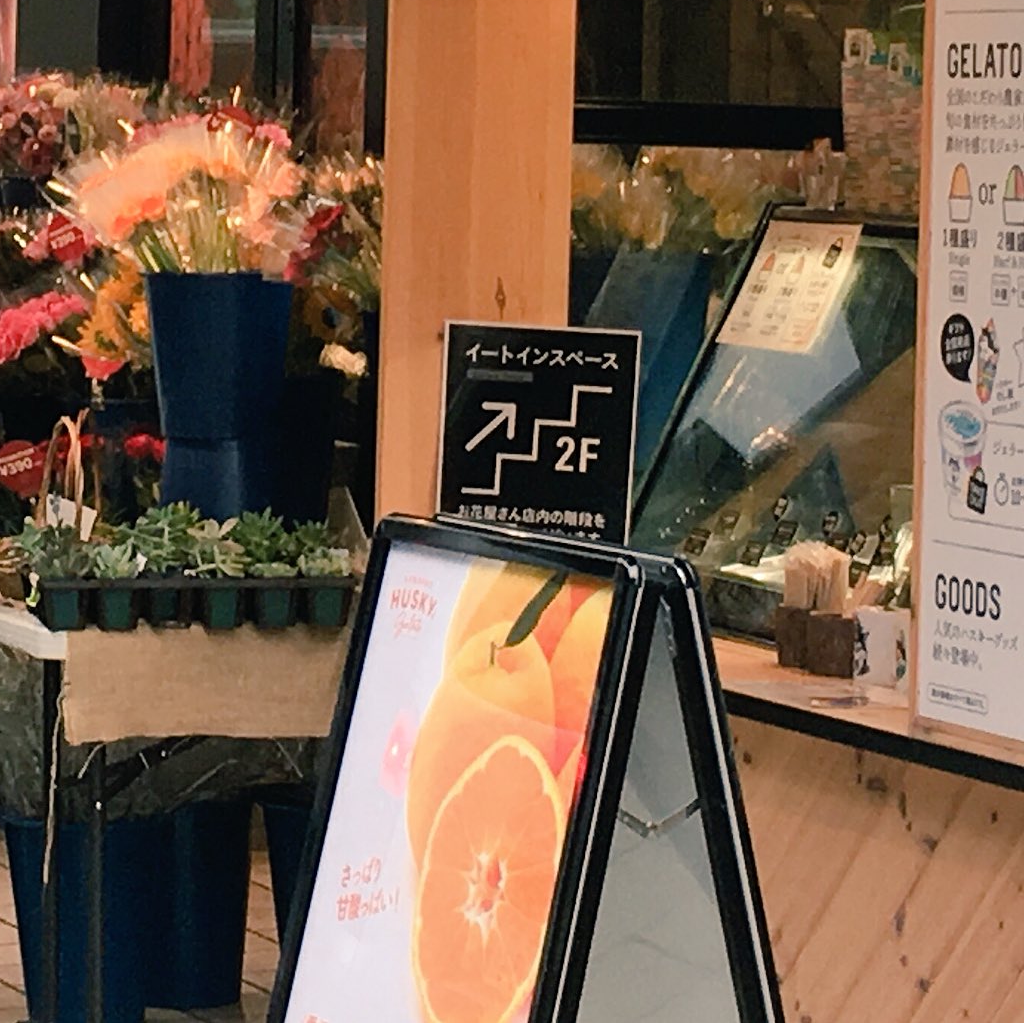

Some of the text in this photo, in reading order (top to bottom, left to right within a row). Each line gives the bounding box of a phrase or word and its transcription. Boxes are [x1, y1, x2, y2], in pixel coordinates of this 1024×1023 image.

[946, 42, 1023, 79] GELATO
[978, 182, 997, 206] or
[465, 343, 619, 370] イートインスペース
[554, 435, 601, 474] 2F
[934, 572, 1002, 621] GOODS
